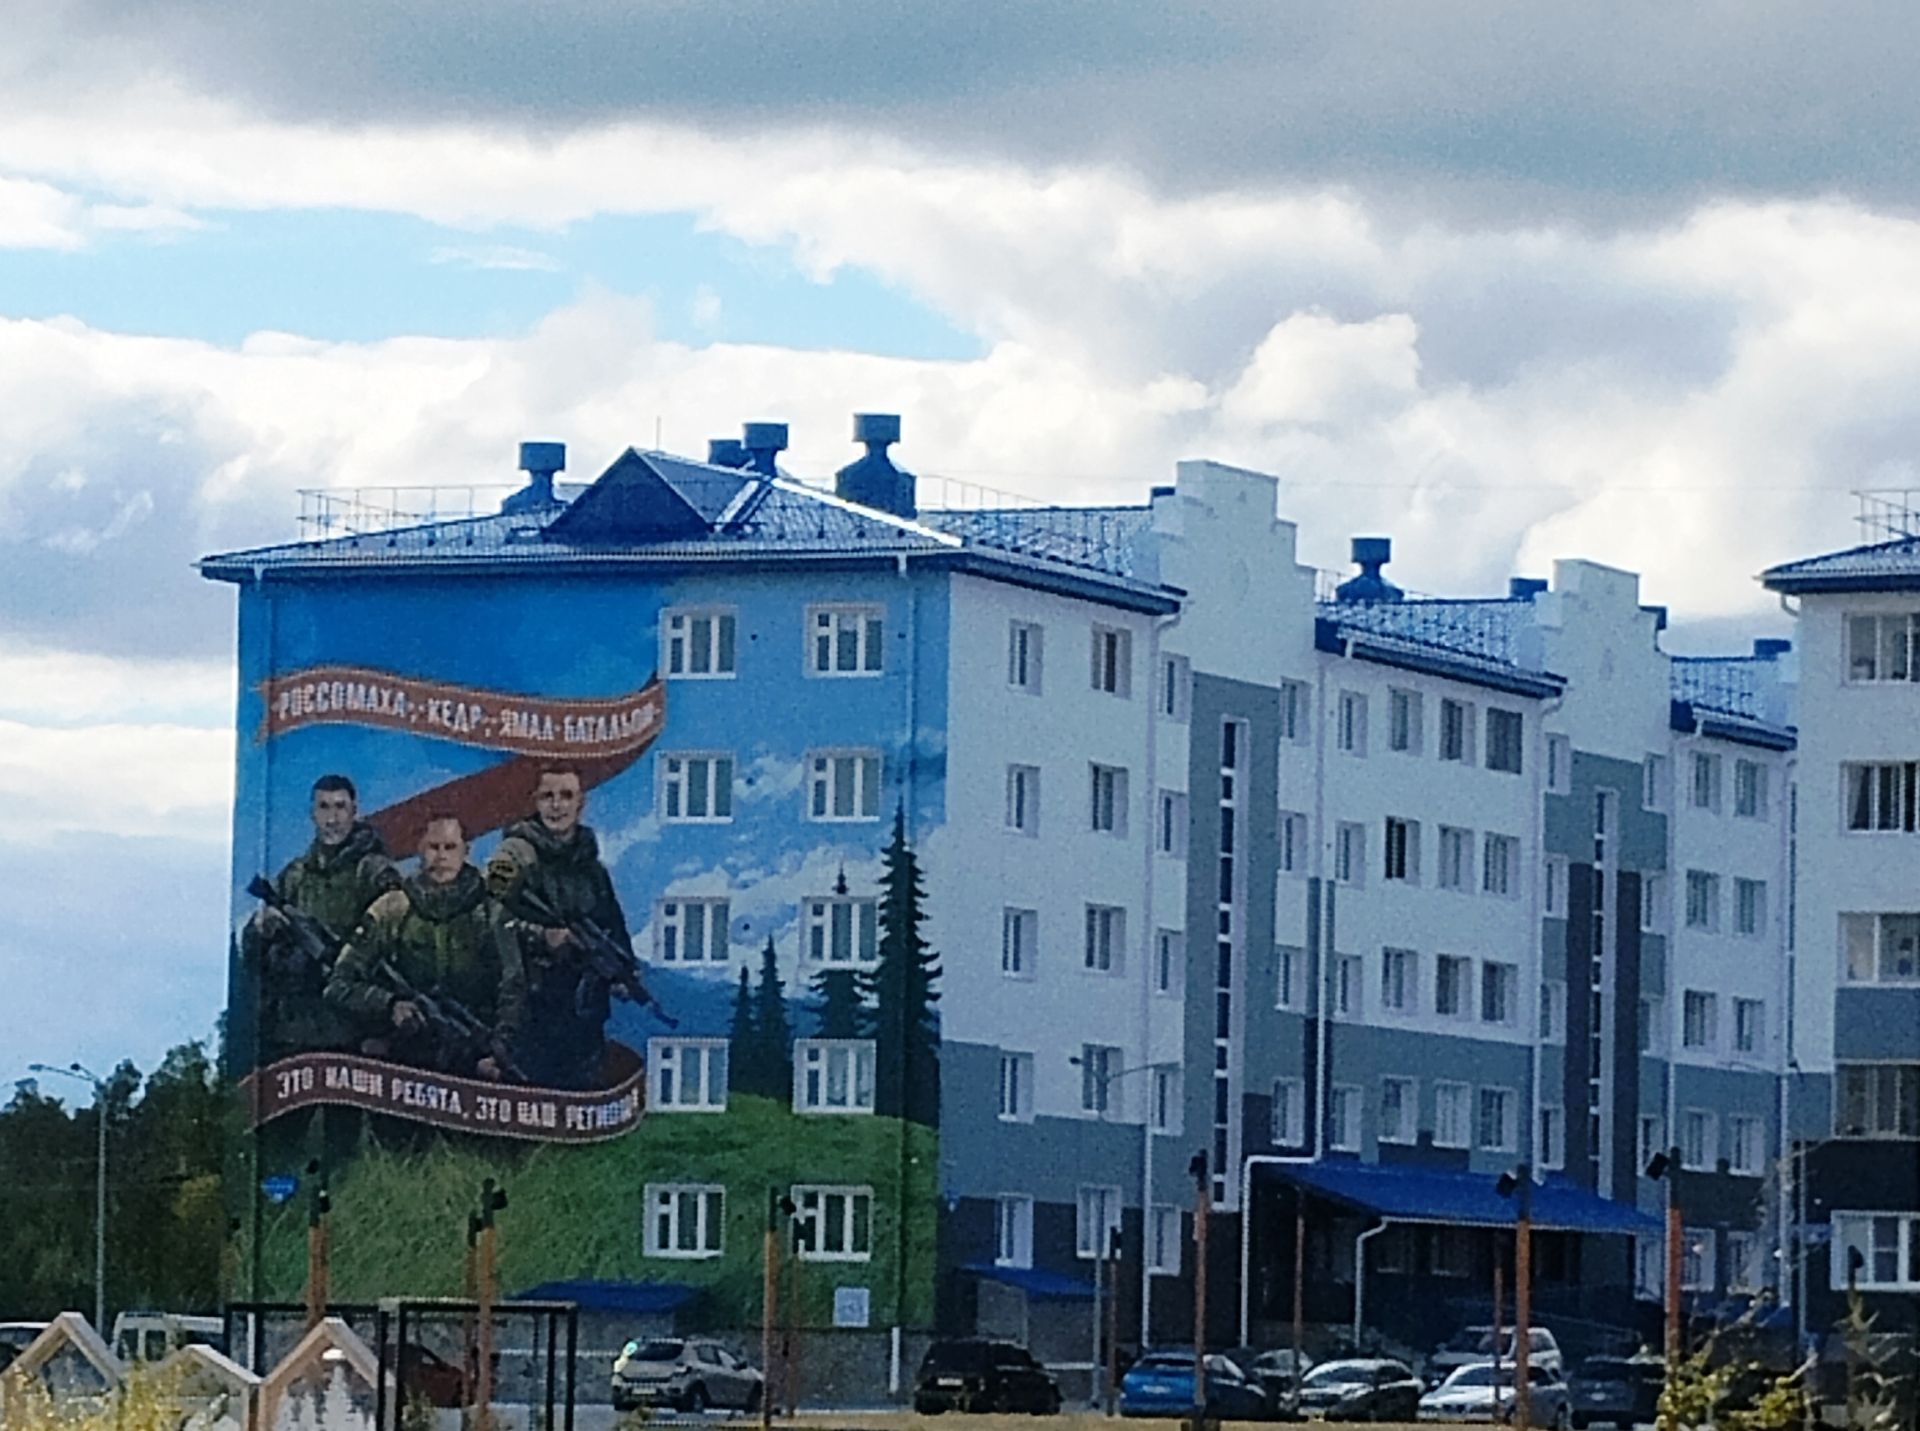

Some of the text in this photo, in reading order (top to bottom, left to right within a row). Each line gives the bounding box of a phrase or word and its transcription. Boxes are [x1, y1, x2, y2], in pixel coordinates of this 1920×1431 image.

[276, 1066, 314, 1098] ЭТО
[325, 1066, 383, 1097] НАШИ
[475, 1095, 511, 1122] ЭТО
[517, 1101, 556, 1128] НАШ
